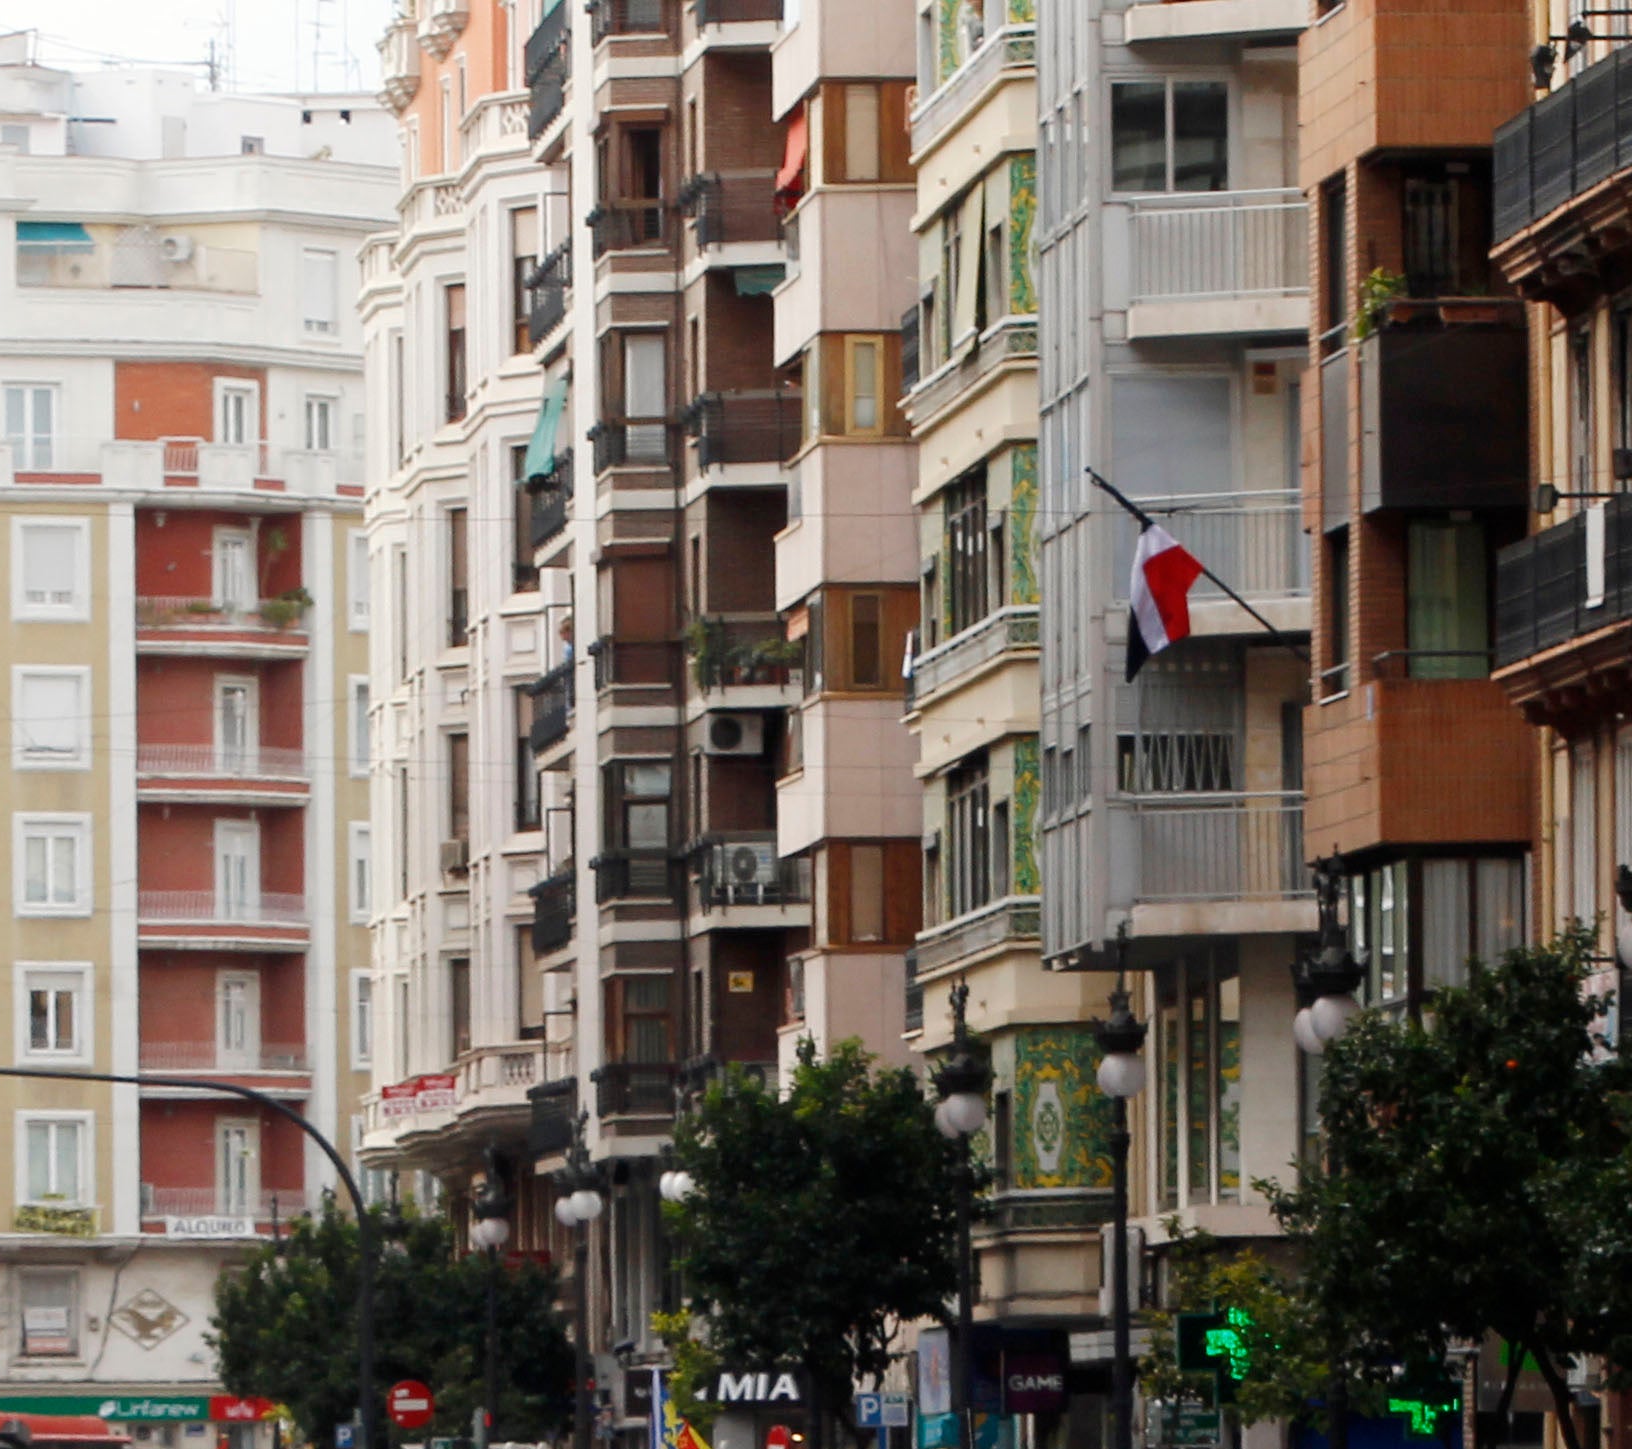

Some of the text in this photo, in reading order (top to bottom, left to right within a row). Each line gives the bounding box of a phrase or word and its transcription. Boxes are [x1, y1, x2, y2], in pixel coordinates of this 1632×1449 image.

[717, 1373, 800, 1402] MIA
[1008, 1374, 1064, 1392] GAME
[861, 1397, 879, 1422] P
